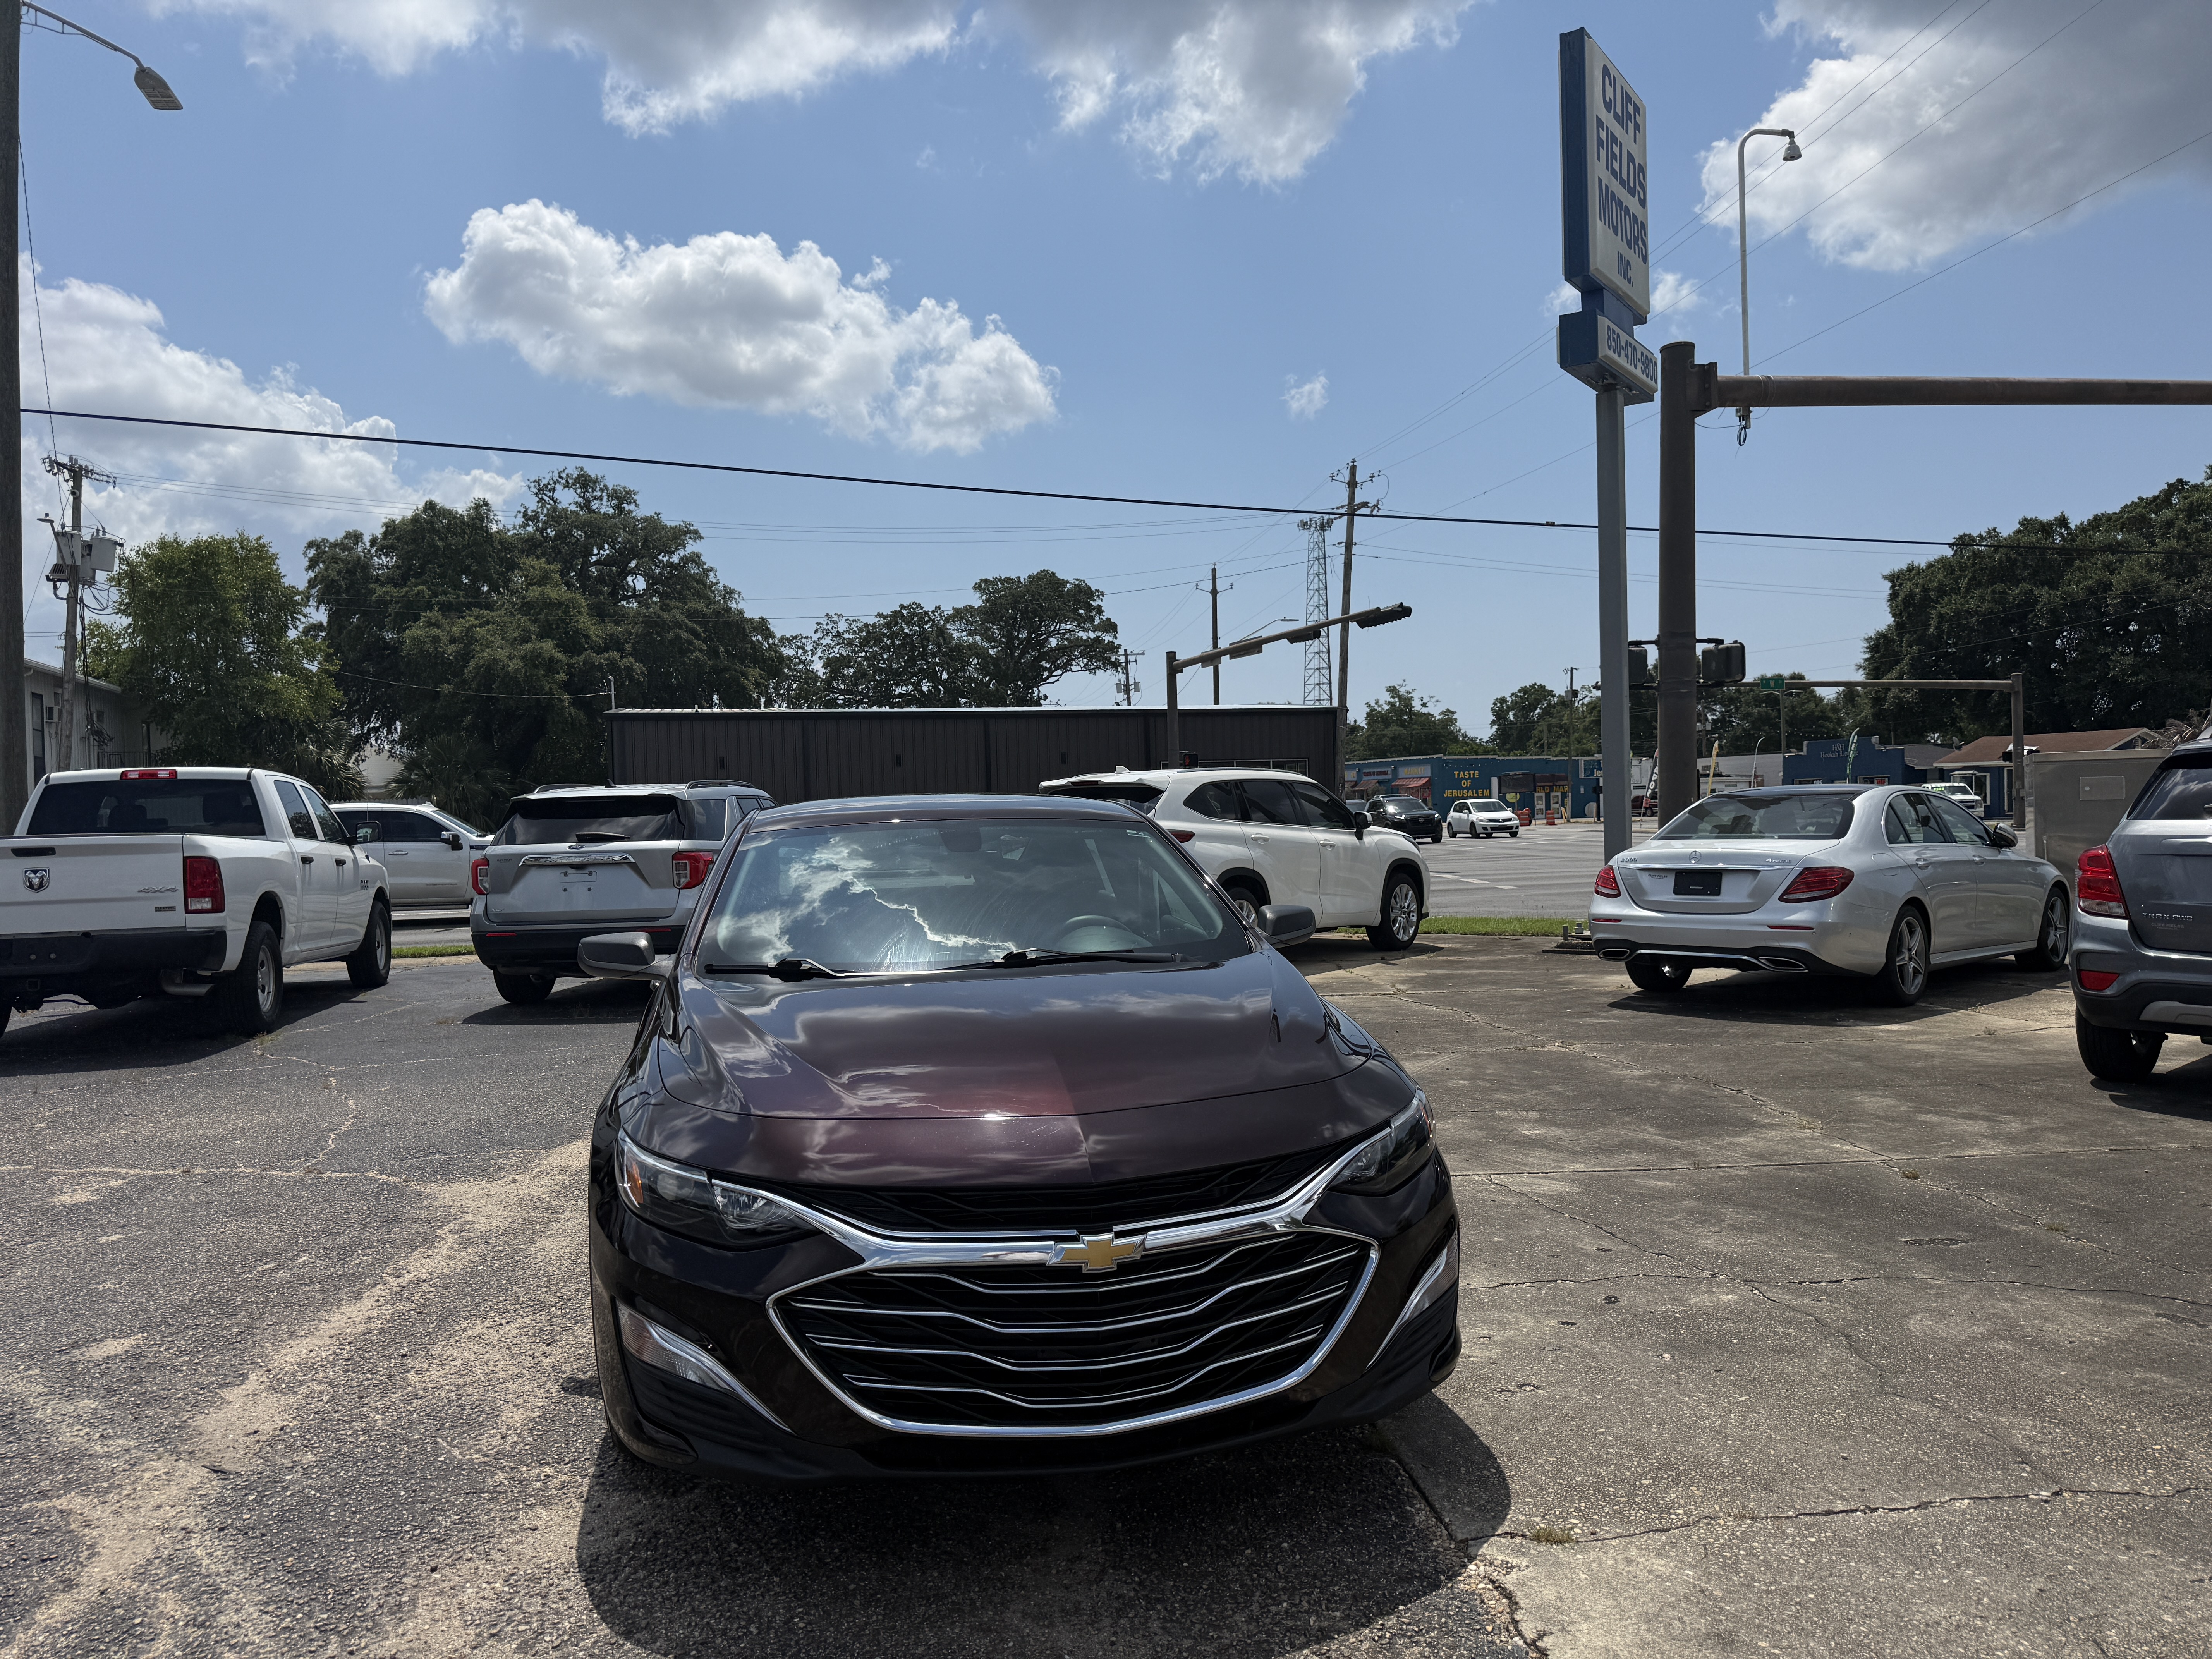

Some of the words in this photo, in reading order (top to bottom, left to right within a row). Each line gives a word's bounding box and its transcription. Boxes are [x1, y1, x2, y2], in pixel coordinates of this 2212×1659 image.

[1602, 64, 1640, 145] CLIFF
[1596, 114, 1646, 210] FIELDS
[1598, 175, 1647, 265] MOTORS
[1617, 250, 1633, 287] INC.
[1607, 325, 1658, 385] 850-470-9800
[1443, 789, 1490, 797] JERUSALEM
